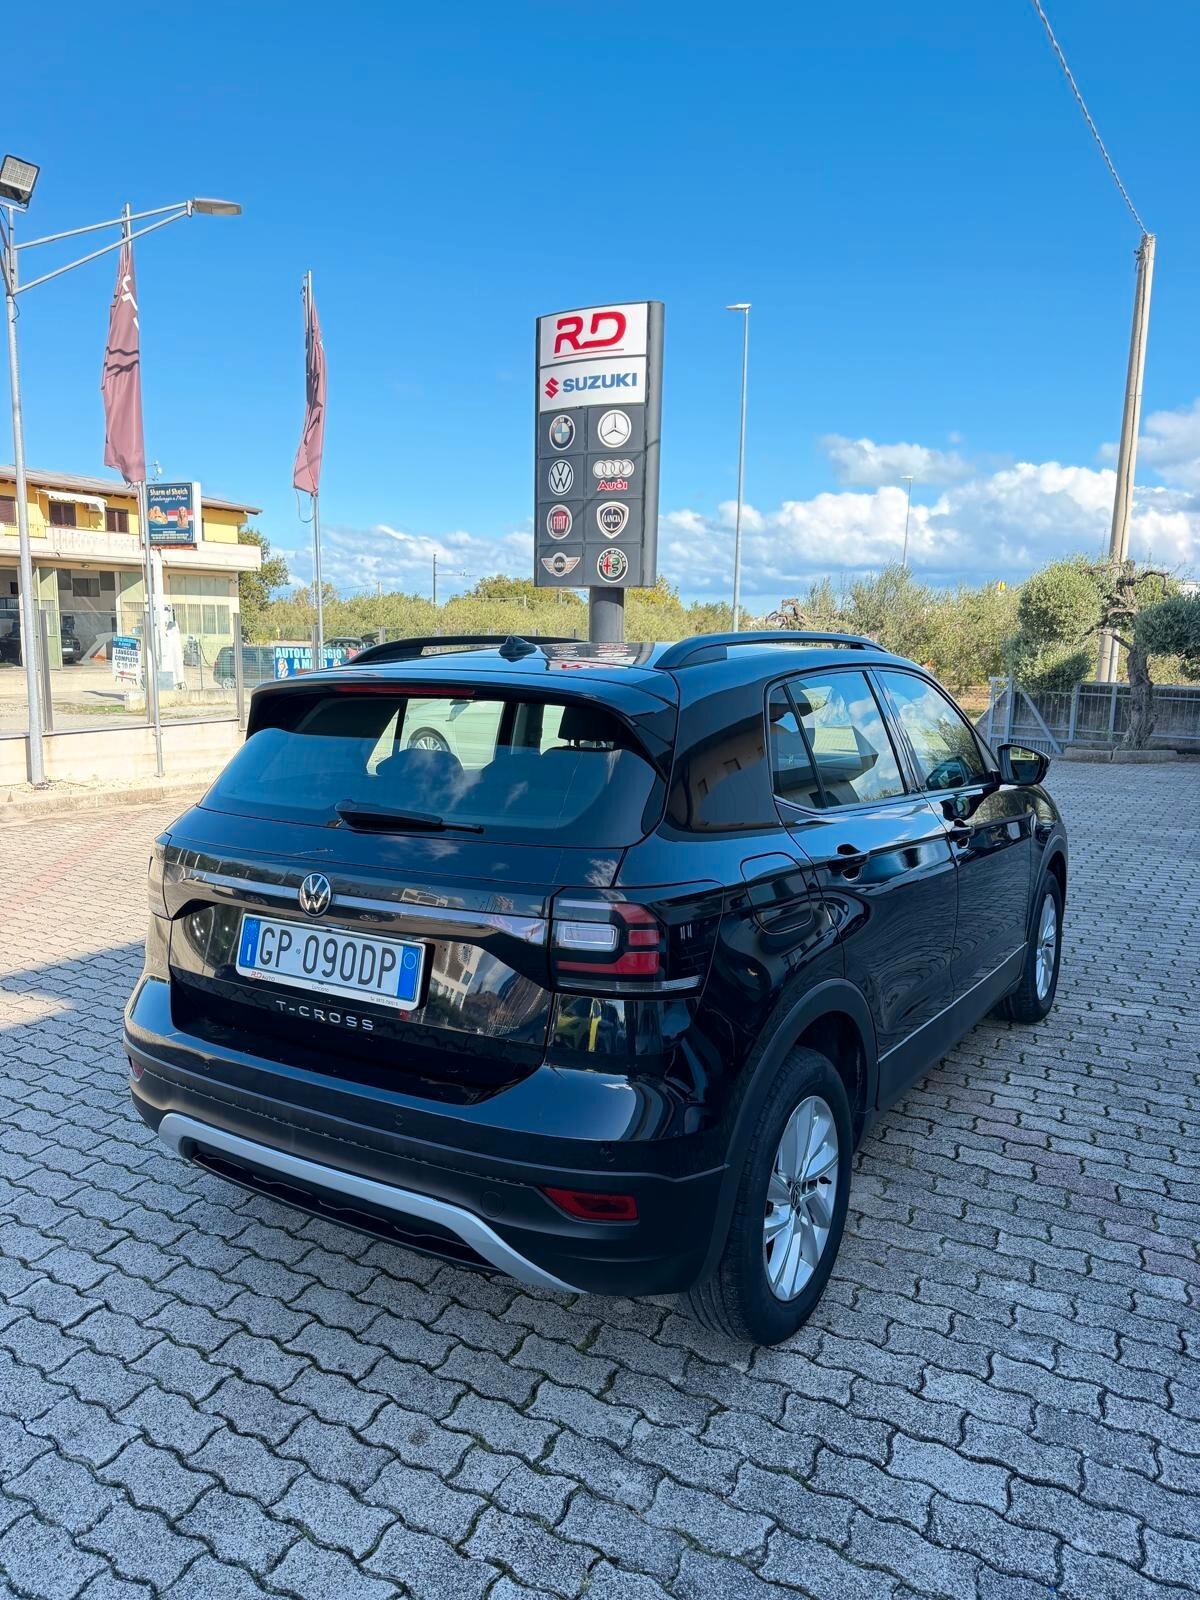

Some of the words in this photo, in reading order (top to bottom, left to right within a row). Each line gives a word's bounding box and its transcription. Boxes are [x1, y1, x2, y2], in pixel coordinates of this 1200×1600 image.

[554, 311, 626, 353] RD
[563, 372, 637, 393] SUZUKI
[597, 478, 628, 491] Audi
[553, 515, 566, 530] FIAT
[604, 514, 621, 523] LANCIA
[293, 658, 300, 669] A
[259, 927, 293, 968] GP
[302, 934, 397, 989] 090DP
[275, 1000, 374, 1031] T-CROSS
